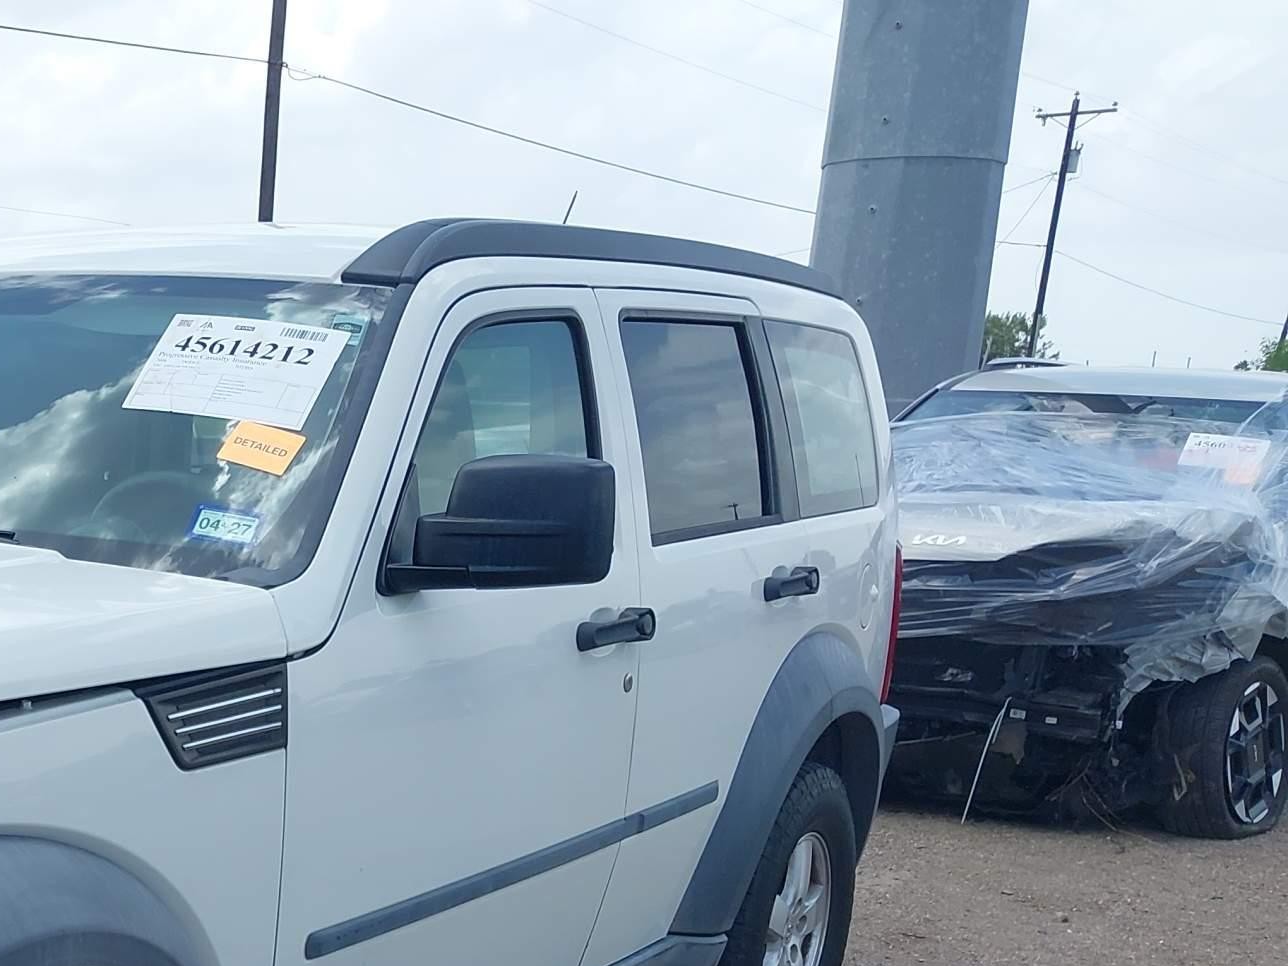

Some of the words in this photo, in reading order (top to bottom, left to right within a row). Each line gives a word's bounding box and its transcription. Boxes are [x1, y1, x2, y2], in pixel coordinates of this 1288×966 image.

[174, 335, 315, 366] 45614212
[233, 436, 288, 458] DETAILED
[198, 517, 222, 531] 04
[227, 522, 253, 536] 27
